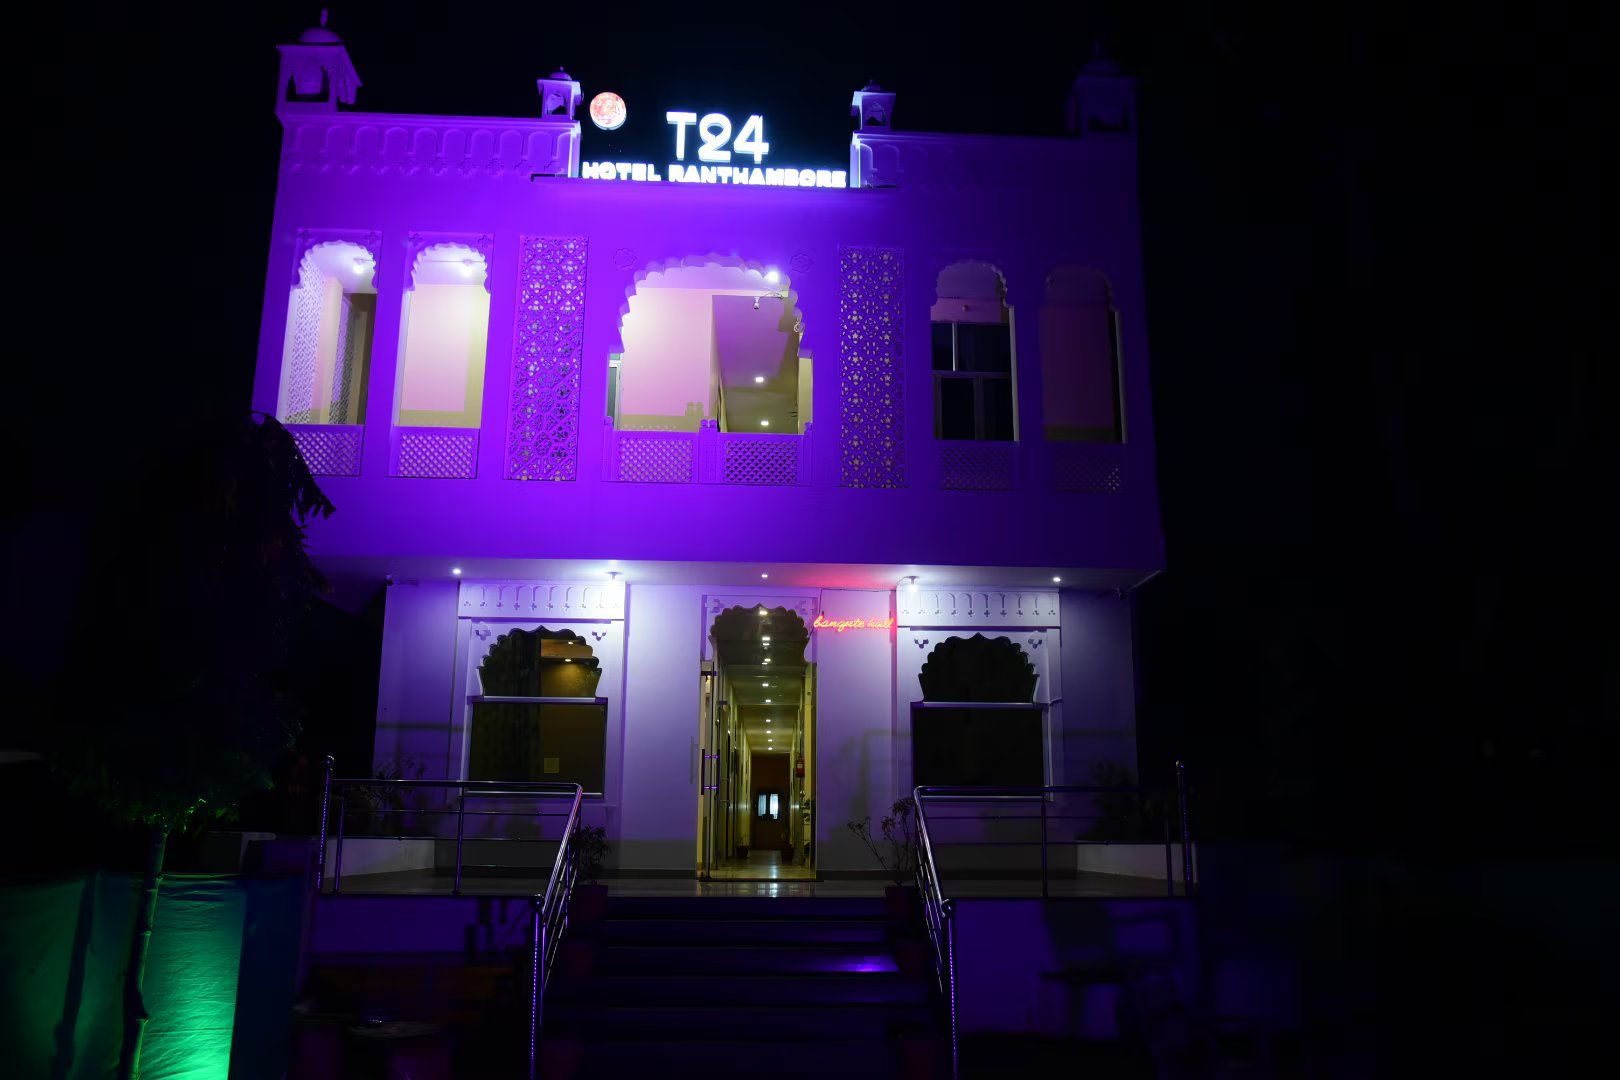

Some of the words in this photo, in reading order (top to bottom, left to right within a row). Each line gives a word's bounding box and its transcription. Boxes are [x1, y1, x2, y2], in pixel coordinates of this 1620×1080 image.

[666, 111, 770, 164] T24
[582, 161, 661, 182] HOTEL
[668, 164, 847, 188] RANTHAMBORE
[866, 617, 894, 629] hall
